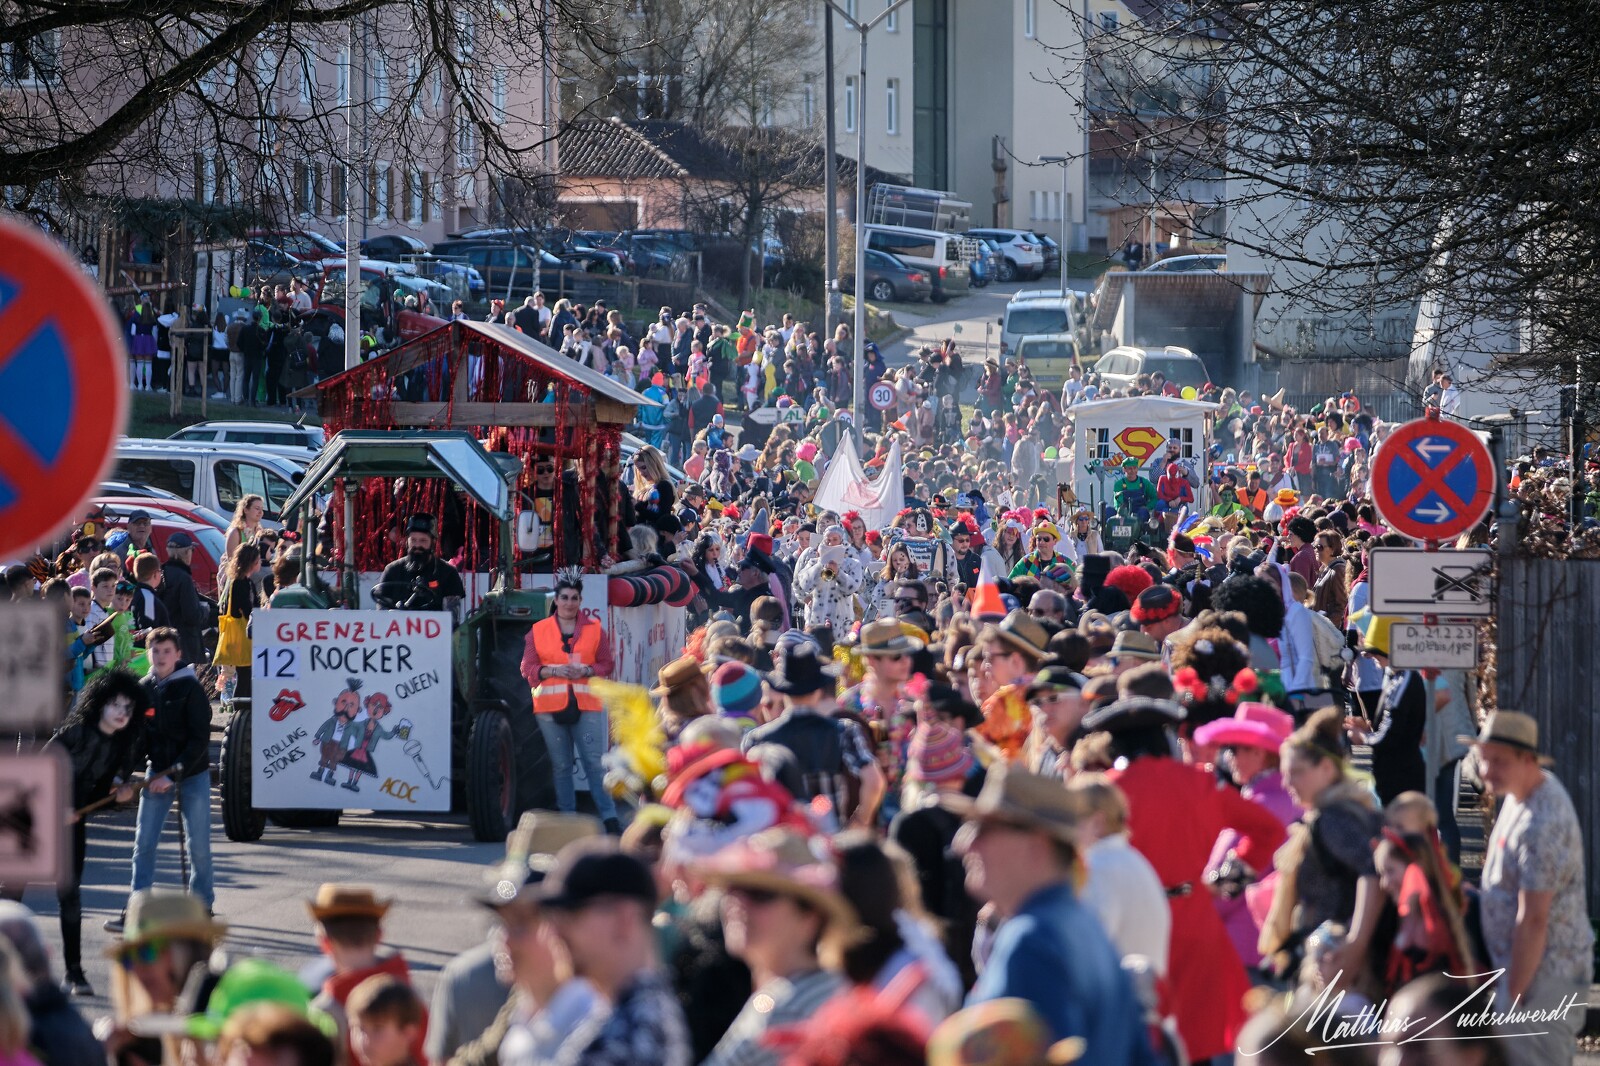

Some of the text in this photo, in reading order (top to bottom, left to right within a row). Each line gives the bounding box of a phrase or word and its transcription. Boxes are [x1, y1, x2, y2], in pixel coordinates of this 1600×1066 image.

[875, 389, 890, 402] 30
[276, 617, 441, 643] GRENZLAND
[256, 648, 296, 678] 12
[310, 644, 413, 674] ROCKER
[395, 669, 439, 700] QUEEN
[262, 726, 308, 761] ROLLING
[262, 746, 307, 779] STONES
[379, 777, 420, 803] ACDC
